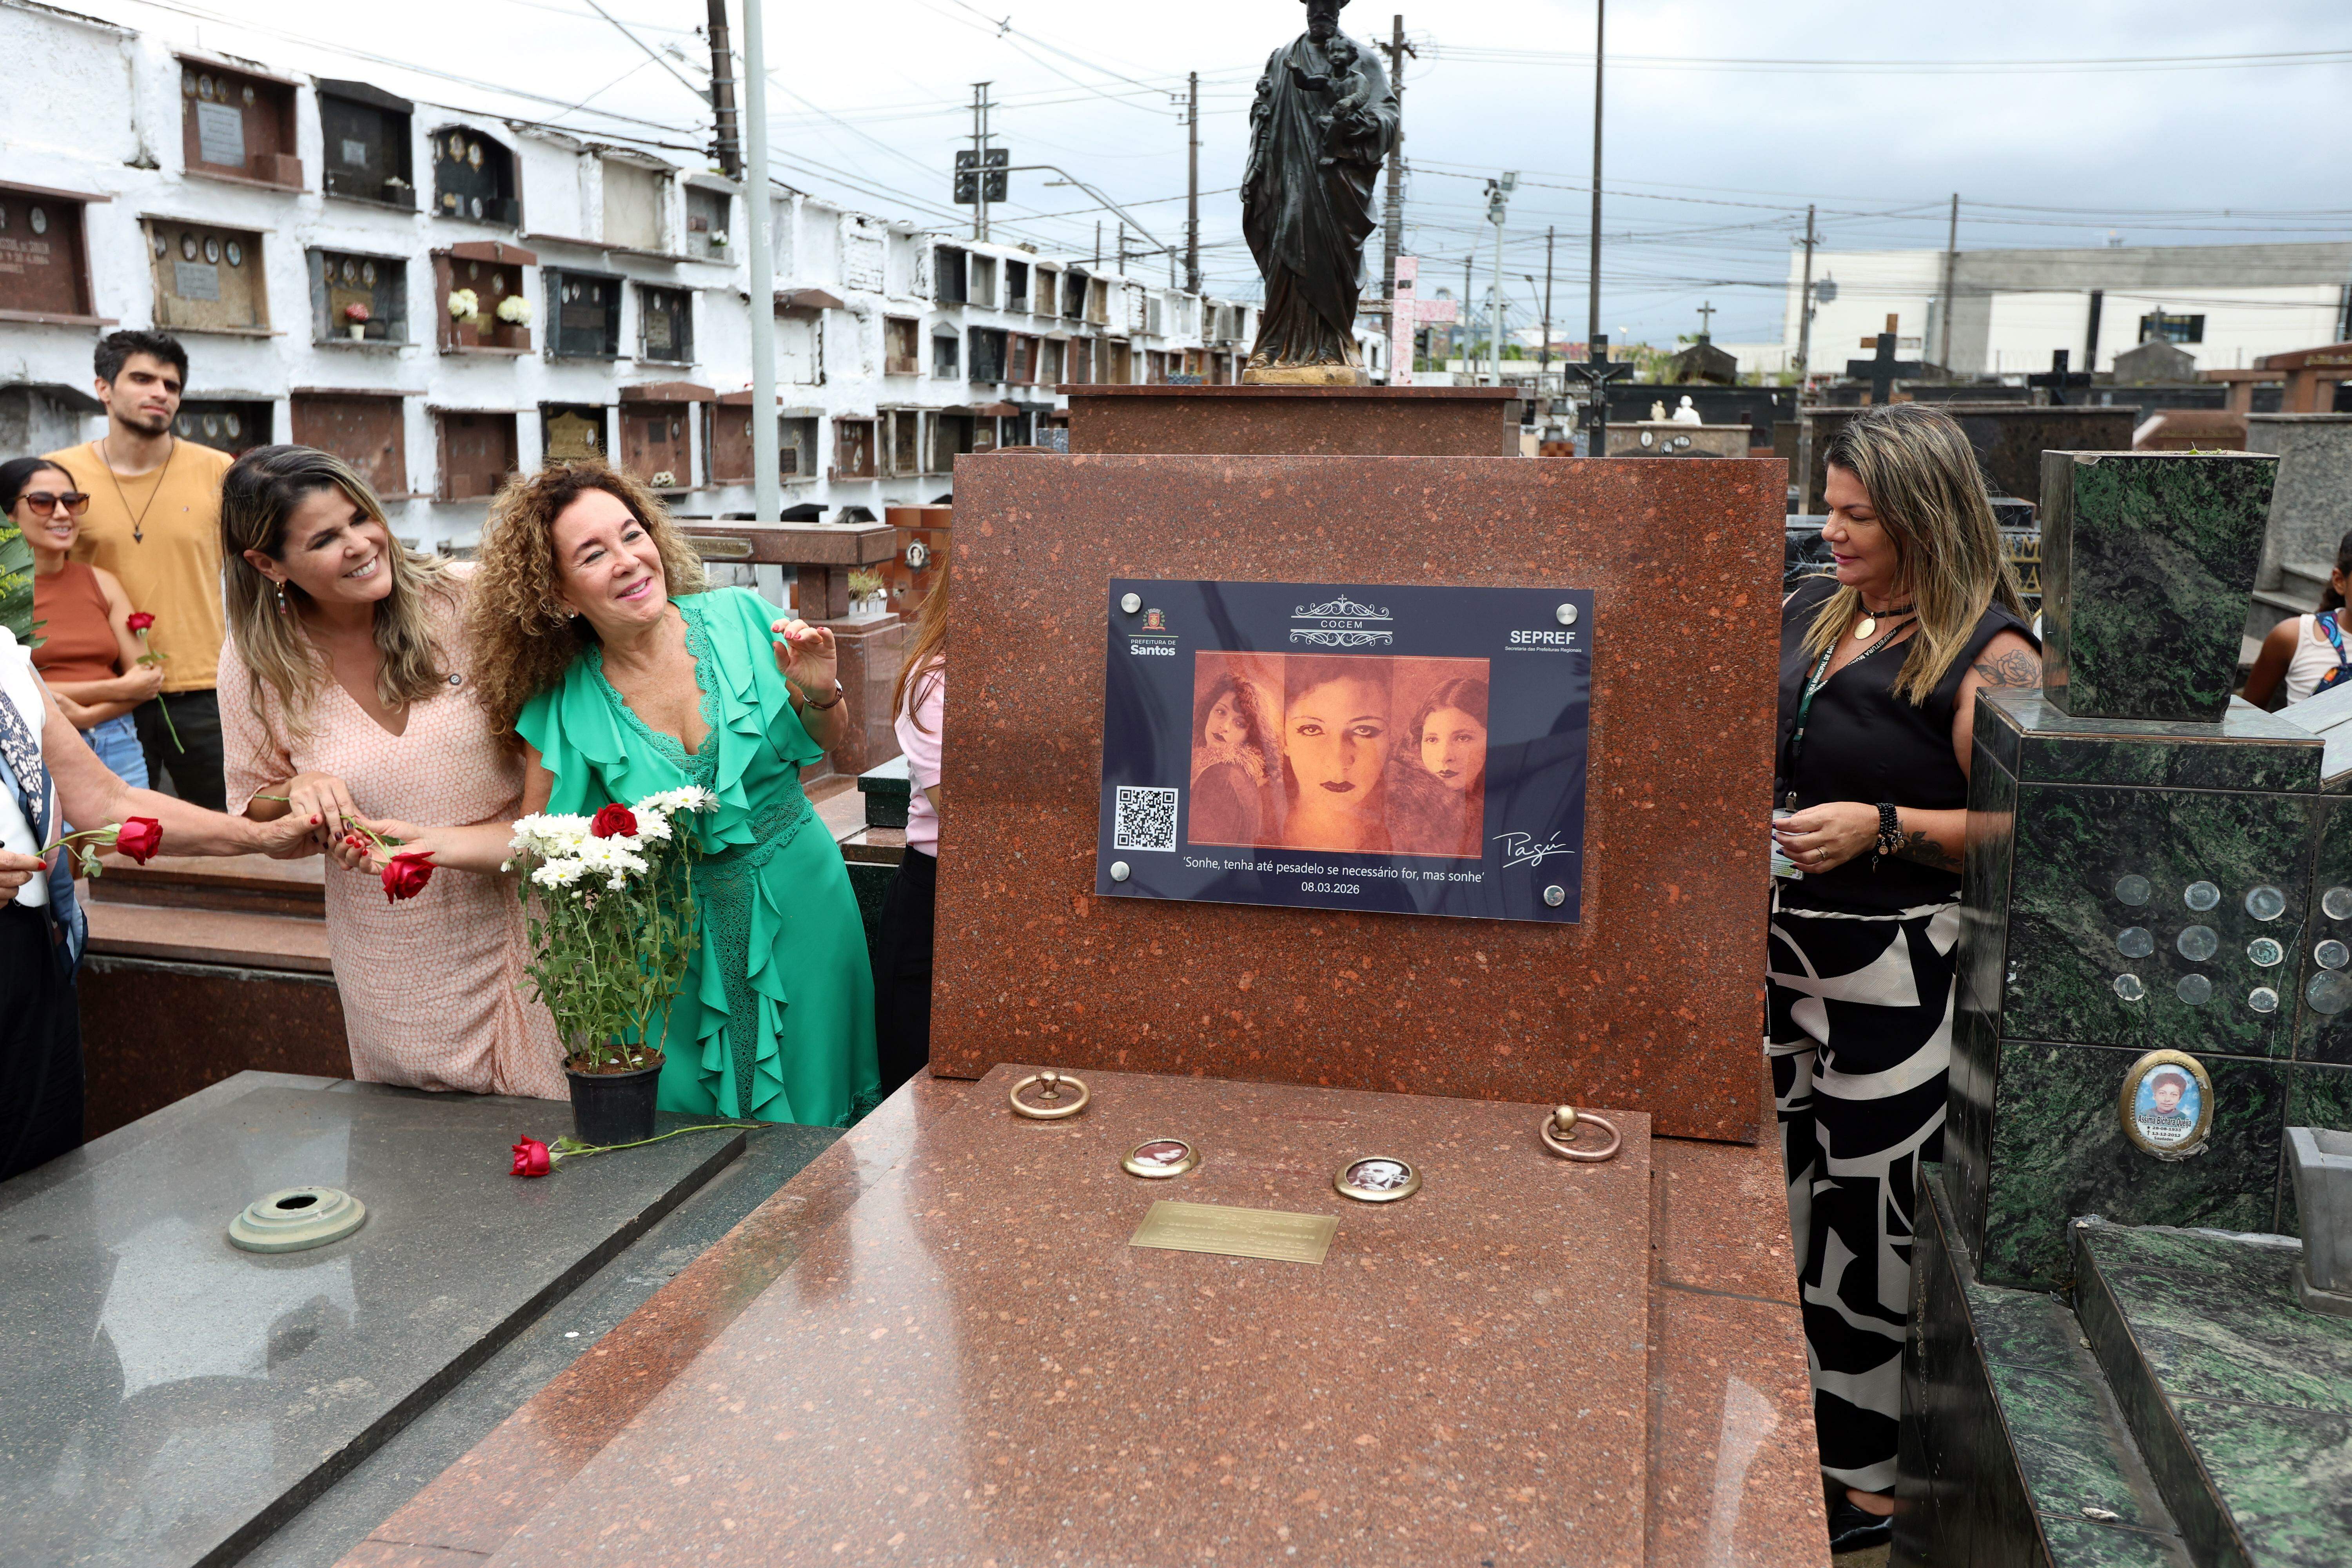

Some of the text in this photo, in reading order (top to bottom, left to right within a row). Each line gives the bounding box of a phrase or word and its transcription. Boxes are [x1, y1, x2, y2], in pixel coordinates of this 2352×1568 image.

[1510, 630, 1576, 644] SEPREF
[1864, 629, 1896, 656] PREFEITURA
[1131, 644, 1176, 655] Santos
[1812, 661, 1828, 684] MUNICIPAL
[1492, 831, 1571, 867] Pagú
[1183, 856, 1485, 882] ‘Sonhe, tenha até pesadelo se necessário for, mas sonhe’
[1301, 882, 1360, 894] 08.03.2026
[2138, 1115, 2192, 1129] Assima Bichara Queija
